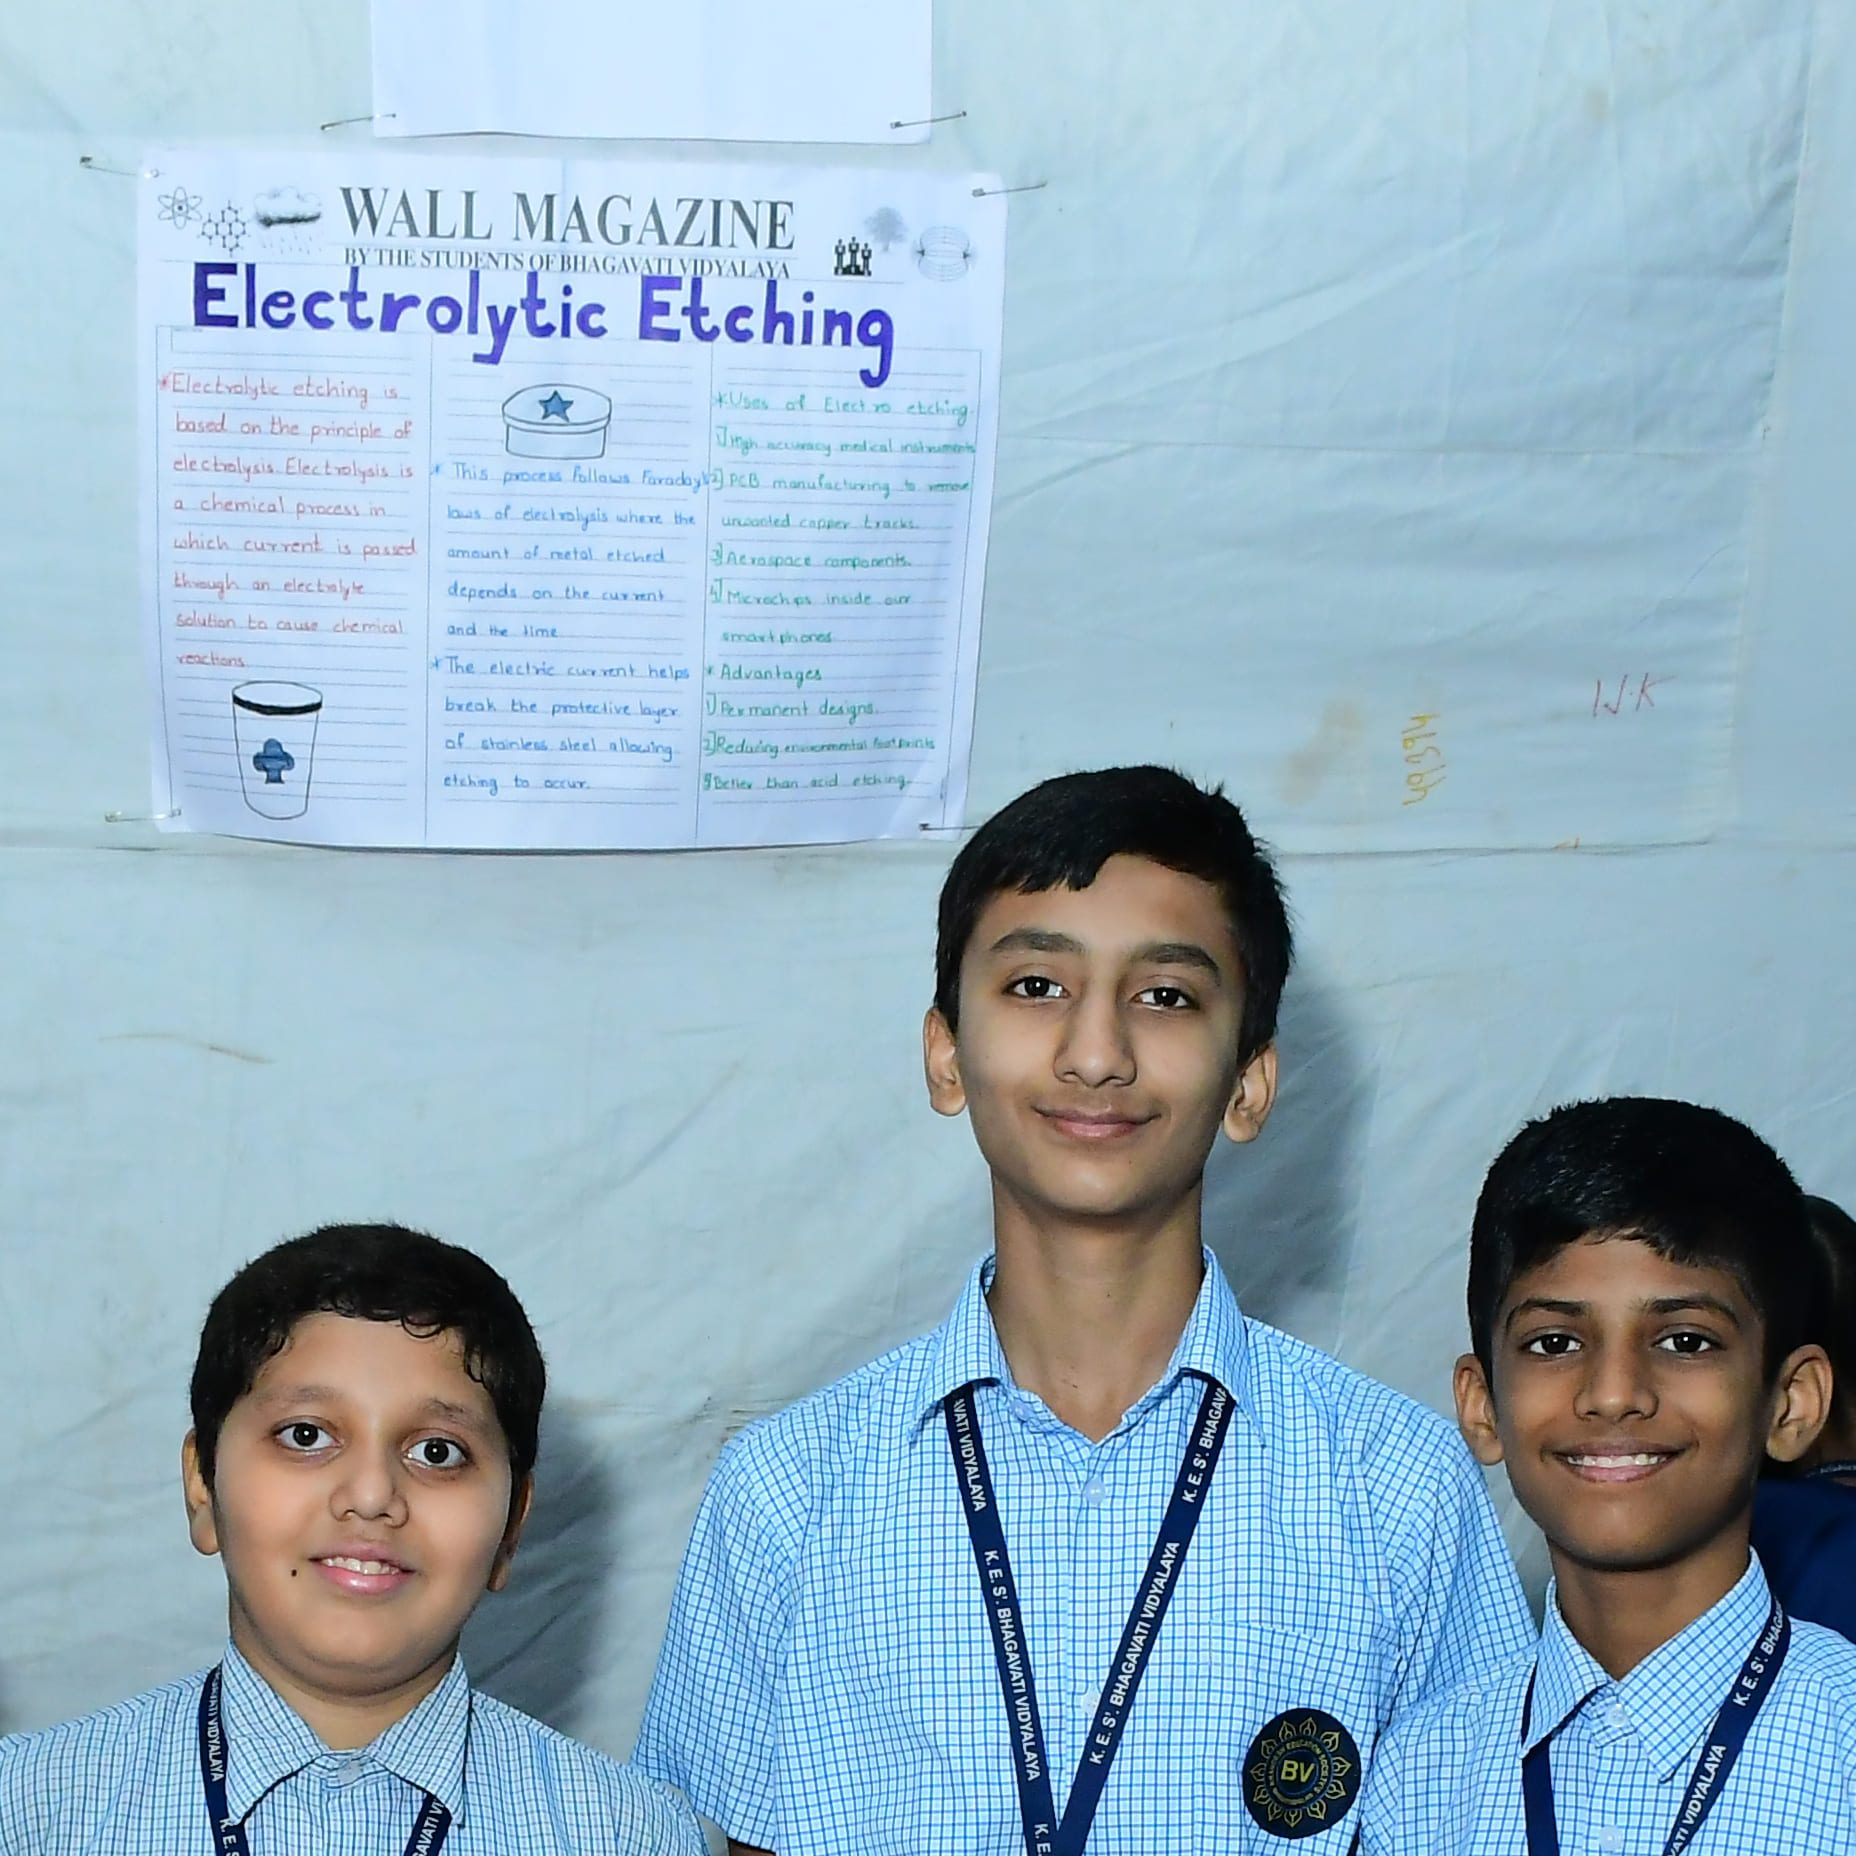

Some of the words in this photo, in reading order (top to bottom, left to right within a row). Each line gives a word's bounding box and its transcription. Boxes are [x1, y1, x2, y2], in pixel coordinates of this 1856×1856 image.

[340, 187, 493, 240] WALL
[513, 192, 796, 250] MAGAZINE
[344, 247, 368, 266] BY
[376, 248, 418, 267] THE
[421, 250, 525, 271] STUDENTS
[528, 253, 556, 272] OF
[560, 254, 672, 276] BHAGAVATI
[679, 258, 791, 280] VIDYALAYA
[193, 261, 609, 366] Electrolytic
[638, 275, 895, 388] Etching
[172, 372, 280, 401] Electrolytic
[293, 375, 369, 410] etching
[383, 383, 399, 399] is
[785, 393, 806, 412] of
[175, 411, 227, 433] based
[240, 420, 262, 435] on
[270, 415, 300, 436] the
[310, 420, 382, 444] principle
[393, 419, 413, 440] of
[285, 456, 389, 484] Electrolysis
[399, 462, 414, 478] is
[452, 461, 489, 482] This
[502, 469, 563, 486] process
[572, 464, 631, 484] follows
[729, 471, 761, 489] PCB
[173, 498, 184, 510] a
[200, 491, 285, 513] chemical
[295, 500, 360, 520] process
[369, 502, 386, 517] in
[447, 504, 482, 521] laws
[494, 504, 511, 521] of
[522, 505, 609, 532] electrolysis
[615, 508, 664, 525] where
[673, 510, 697, 526] the
[799, 516, 851, 531] copper
[174, 531, 229, 551] which
[243, 533, 324, 553] current
[336, 538, 352, 555] is
[362, 537, 418, 562] passed
[447, 547, 510, 561] amount
[523, 545, 540, 561] of
[550, 546, 594, 561] metal
[606, 546, 666, 563] etched
[727, 551, 812, 569] Aerospace
[174, 571, 239, 600] through
[252, 579, 270, 592] an
[283, 577, 365, 601] electrolyte
[447, 579, 517, 603] depends
[532, 587, 553, 600] on
[564, 584, 591, 600] the
[601, 588, 665, 602] current
[827, 592, 872, 607] inside
[176, 610, 236, 629] solution
[247, 614, 268, 631] to
[276, 620, 319, 632] cause
[333, 617, 403, 635] chemical
[446, 622, 478, 637] and
[489, 623, 509, 638] the
[446, 655, 476, 675] The
[489, 659, 556, 677] electric
[567, 662, 635, 679] current
[648, 662, 691, 682] helps
[720, 663, 823, 689] Advantages
[444, 695, 497, 713] break
[510, 697, 538, 714] the
[551, 698, 632, 717] protective
[444, 731, 465, 751] of
[559, 737, 596, 753] steel
[608, 738, 674, 763] allowing
[443, 773, 499, 797] etching
[514, 774, 530, 789] to
[766, 776, 800, 790] than
[810, 773, 840, 788] acid
[959, 1433, 988, 1513] VIDYALAYA
[1109, 1620, 1152, 1707] BHAGAVATI
[1140, 1540, 1181, 1618] VIDYALAYA
[996, 1607, 1028, 1693] BHAGAVATI
[1014, 1695, 1042, 1782] VIDYALAYA
[207, 1717, 225, 1783] VIDYALAYA
[1280, 1759, 1316, 1783] BV
[1682, 1743, 1727, 1827] VIDYALAYA
